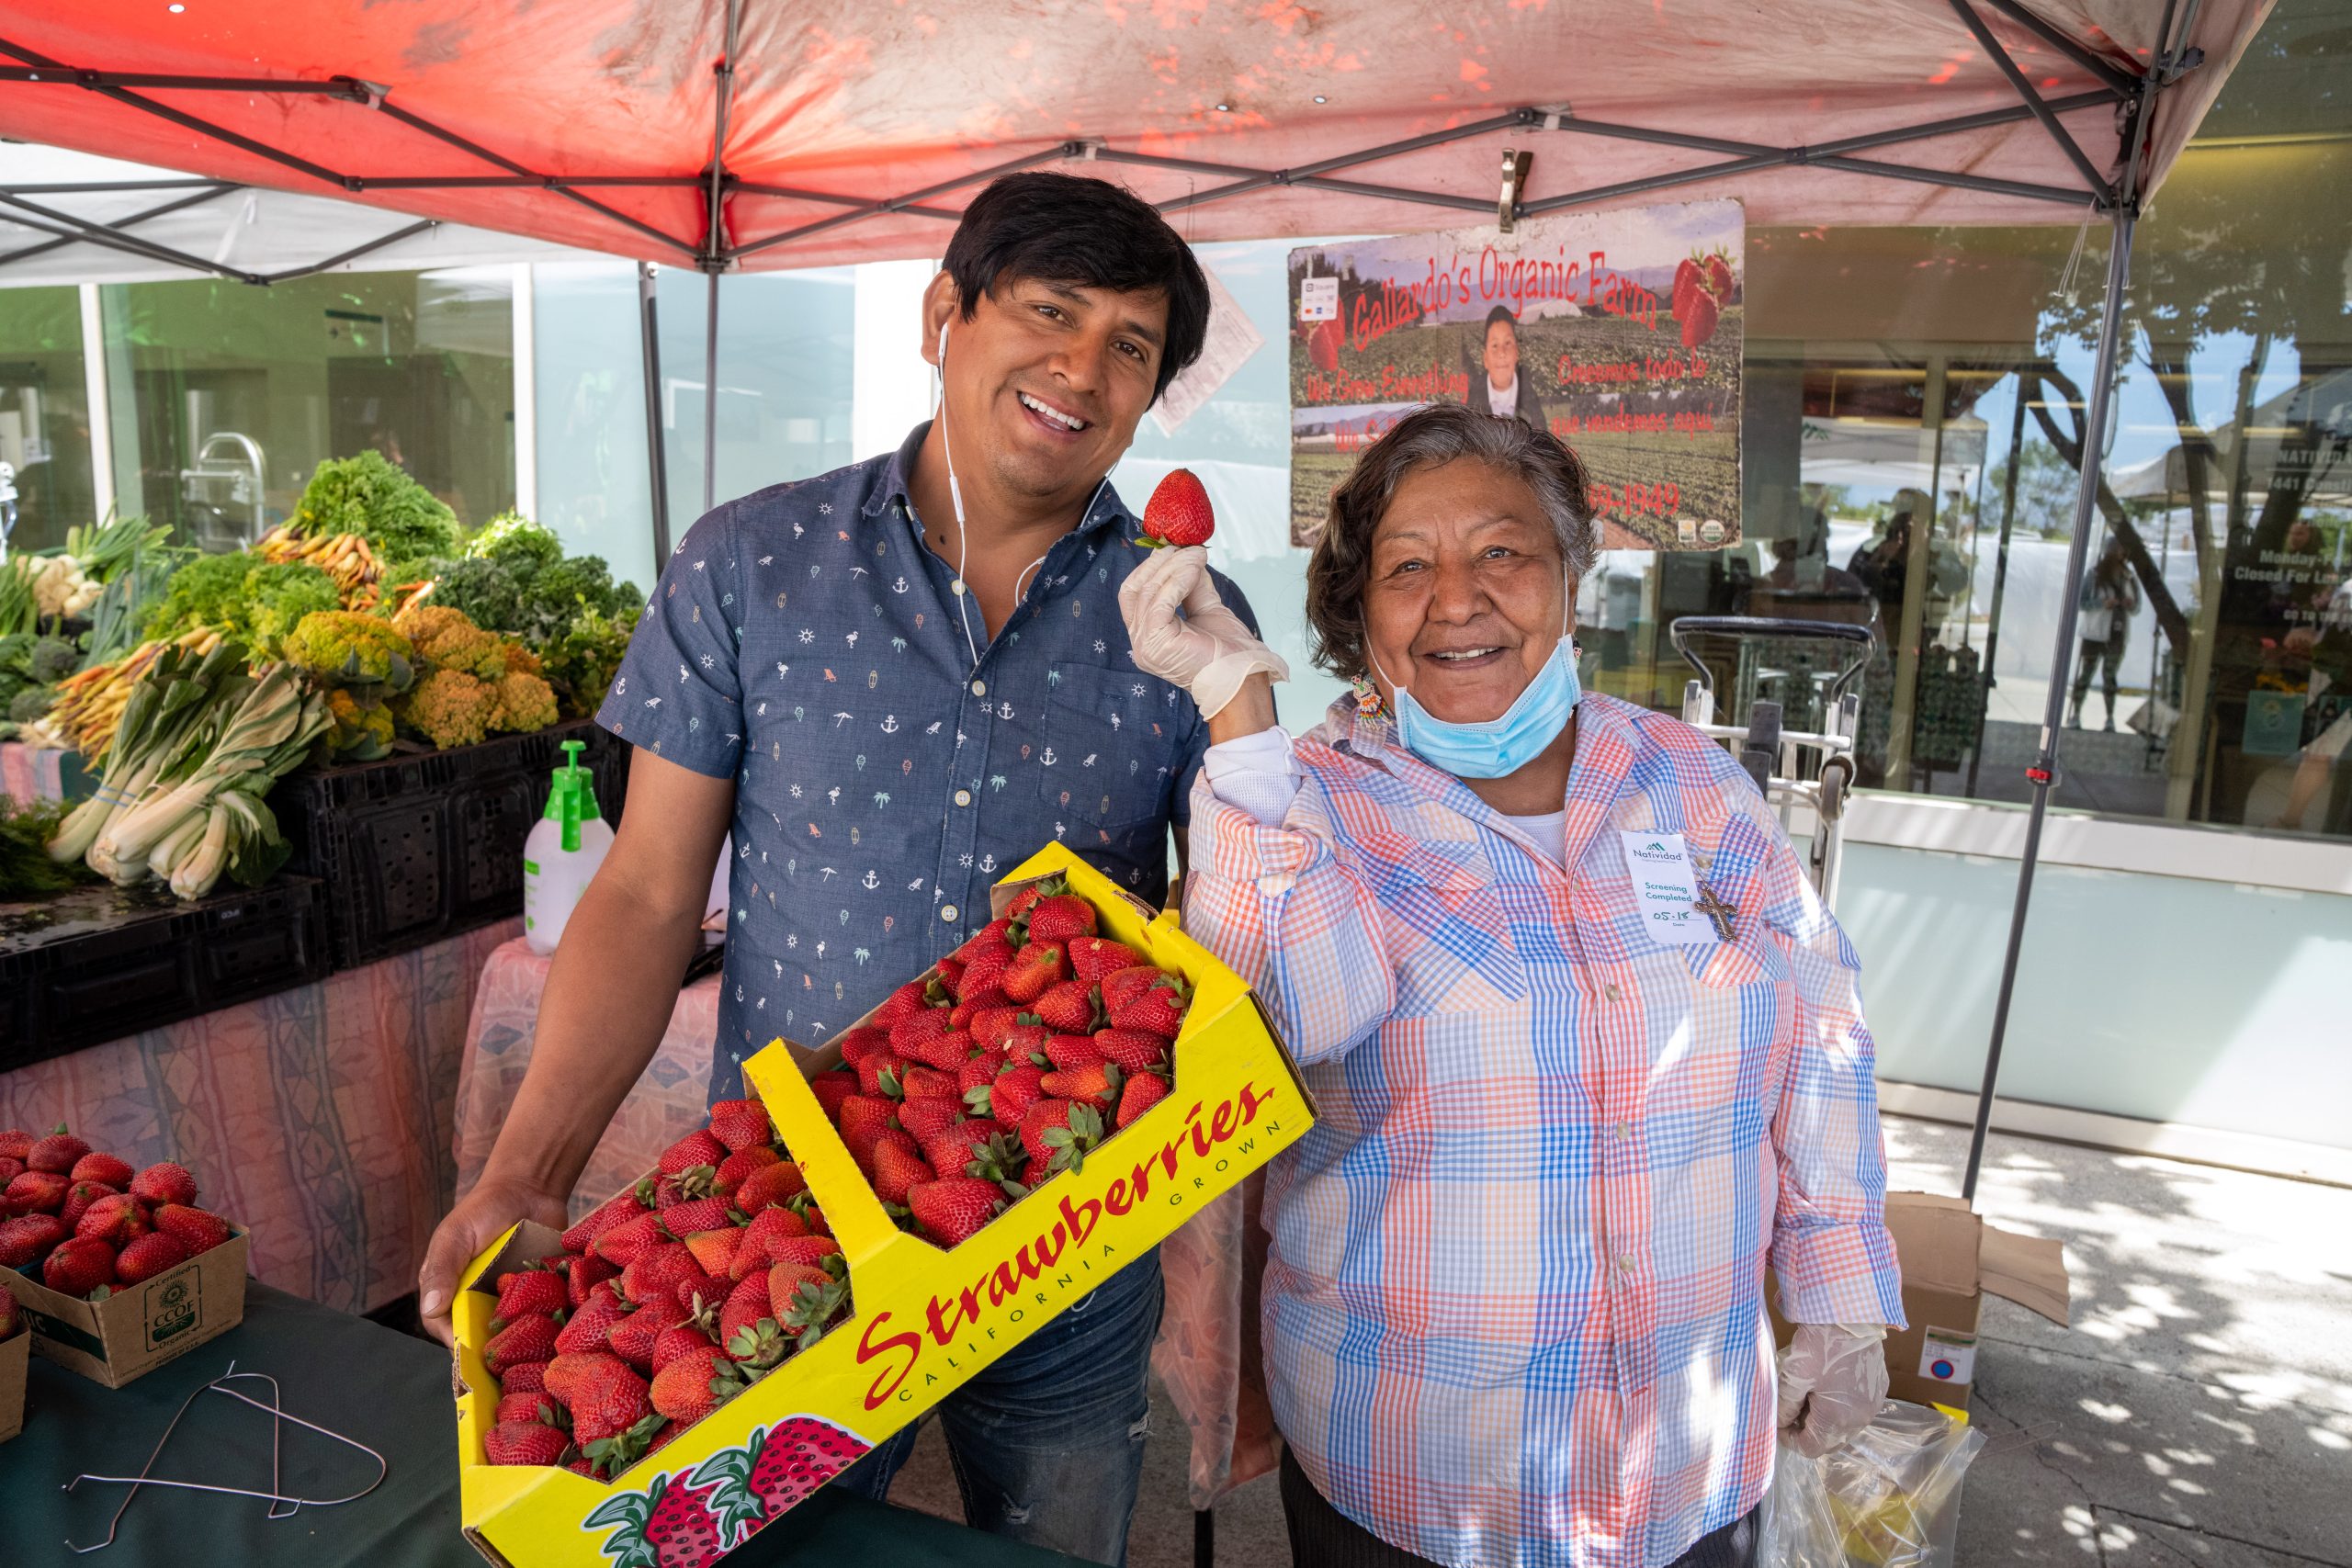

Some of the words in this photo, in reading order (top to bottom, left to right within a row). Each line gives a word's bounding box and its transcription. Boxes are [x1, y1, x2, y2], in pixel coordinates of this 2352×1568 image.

[1352, 254, 1470, 353] Gallardo's
[1480, 243, 1579, 319] Organic
[1587, 251, 1657, 332] Farm
[1645, 346, 1685, 381] todo
[1690, 345, 1710, 378] lo
[1307, 368, 1330, 401] We
[1336, 367, 1377, 400] Grow
[1381, 359, 1469, 405] Everything
[1550, 415, 1581, 441] que
[1585, 400, 1668, 434] vendemos
[1335, 419, 1360, 453] We
[2234, 566, 2283, 582] Closed
[2286, 568, 2311, 583] For
[1633, 849, 1682, 861] Natividad
[1645, 882, 1688, 894] Screening
[1645, 892, 1692, 902] Completed
[855, 1081, 1275, 1411] Strawberries
[155, 1265, 192, 1287] Certified
[899, 1243, 1116, 1403] CALIFORNIA
[1169, 1120, 1281, 1206] GROWN
[154, 1300, 195, 1327] CCOF
[159, 1329, 191, 1349] Organic
